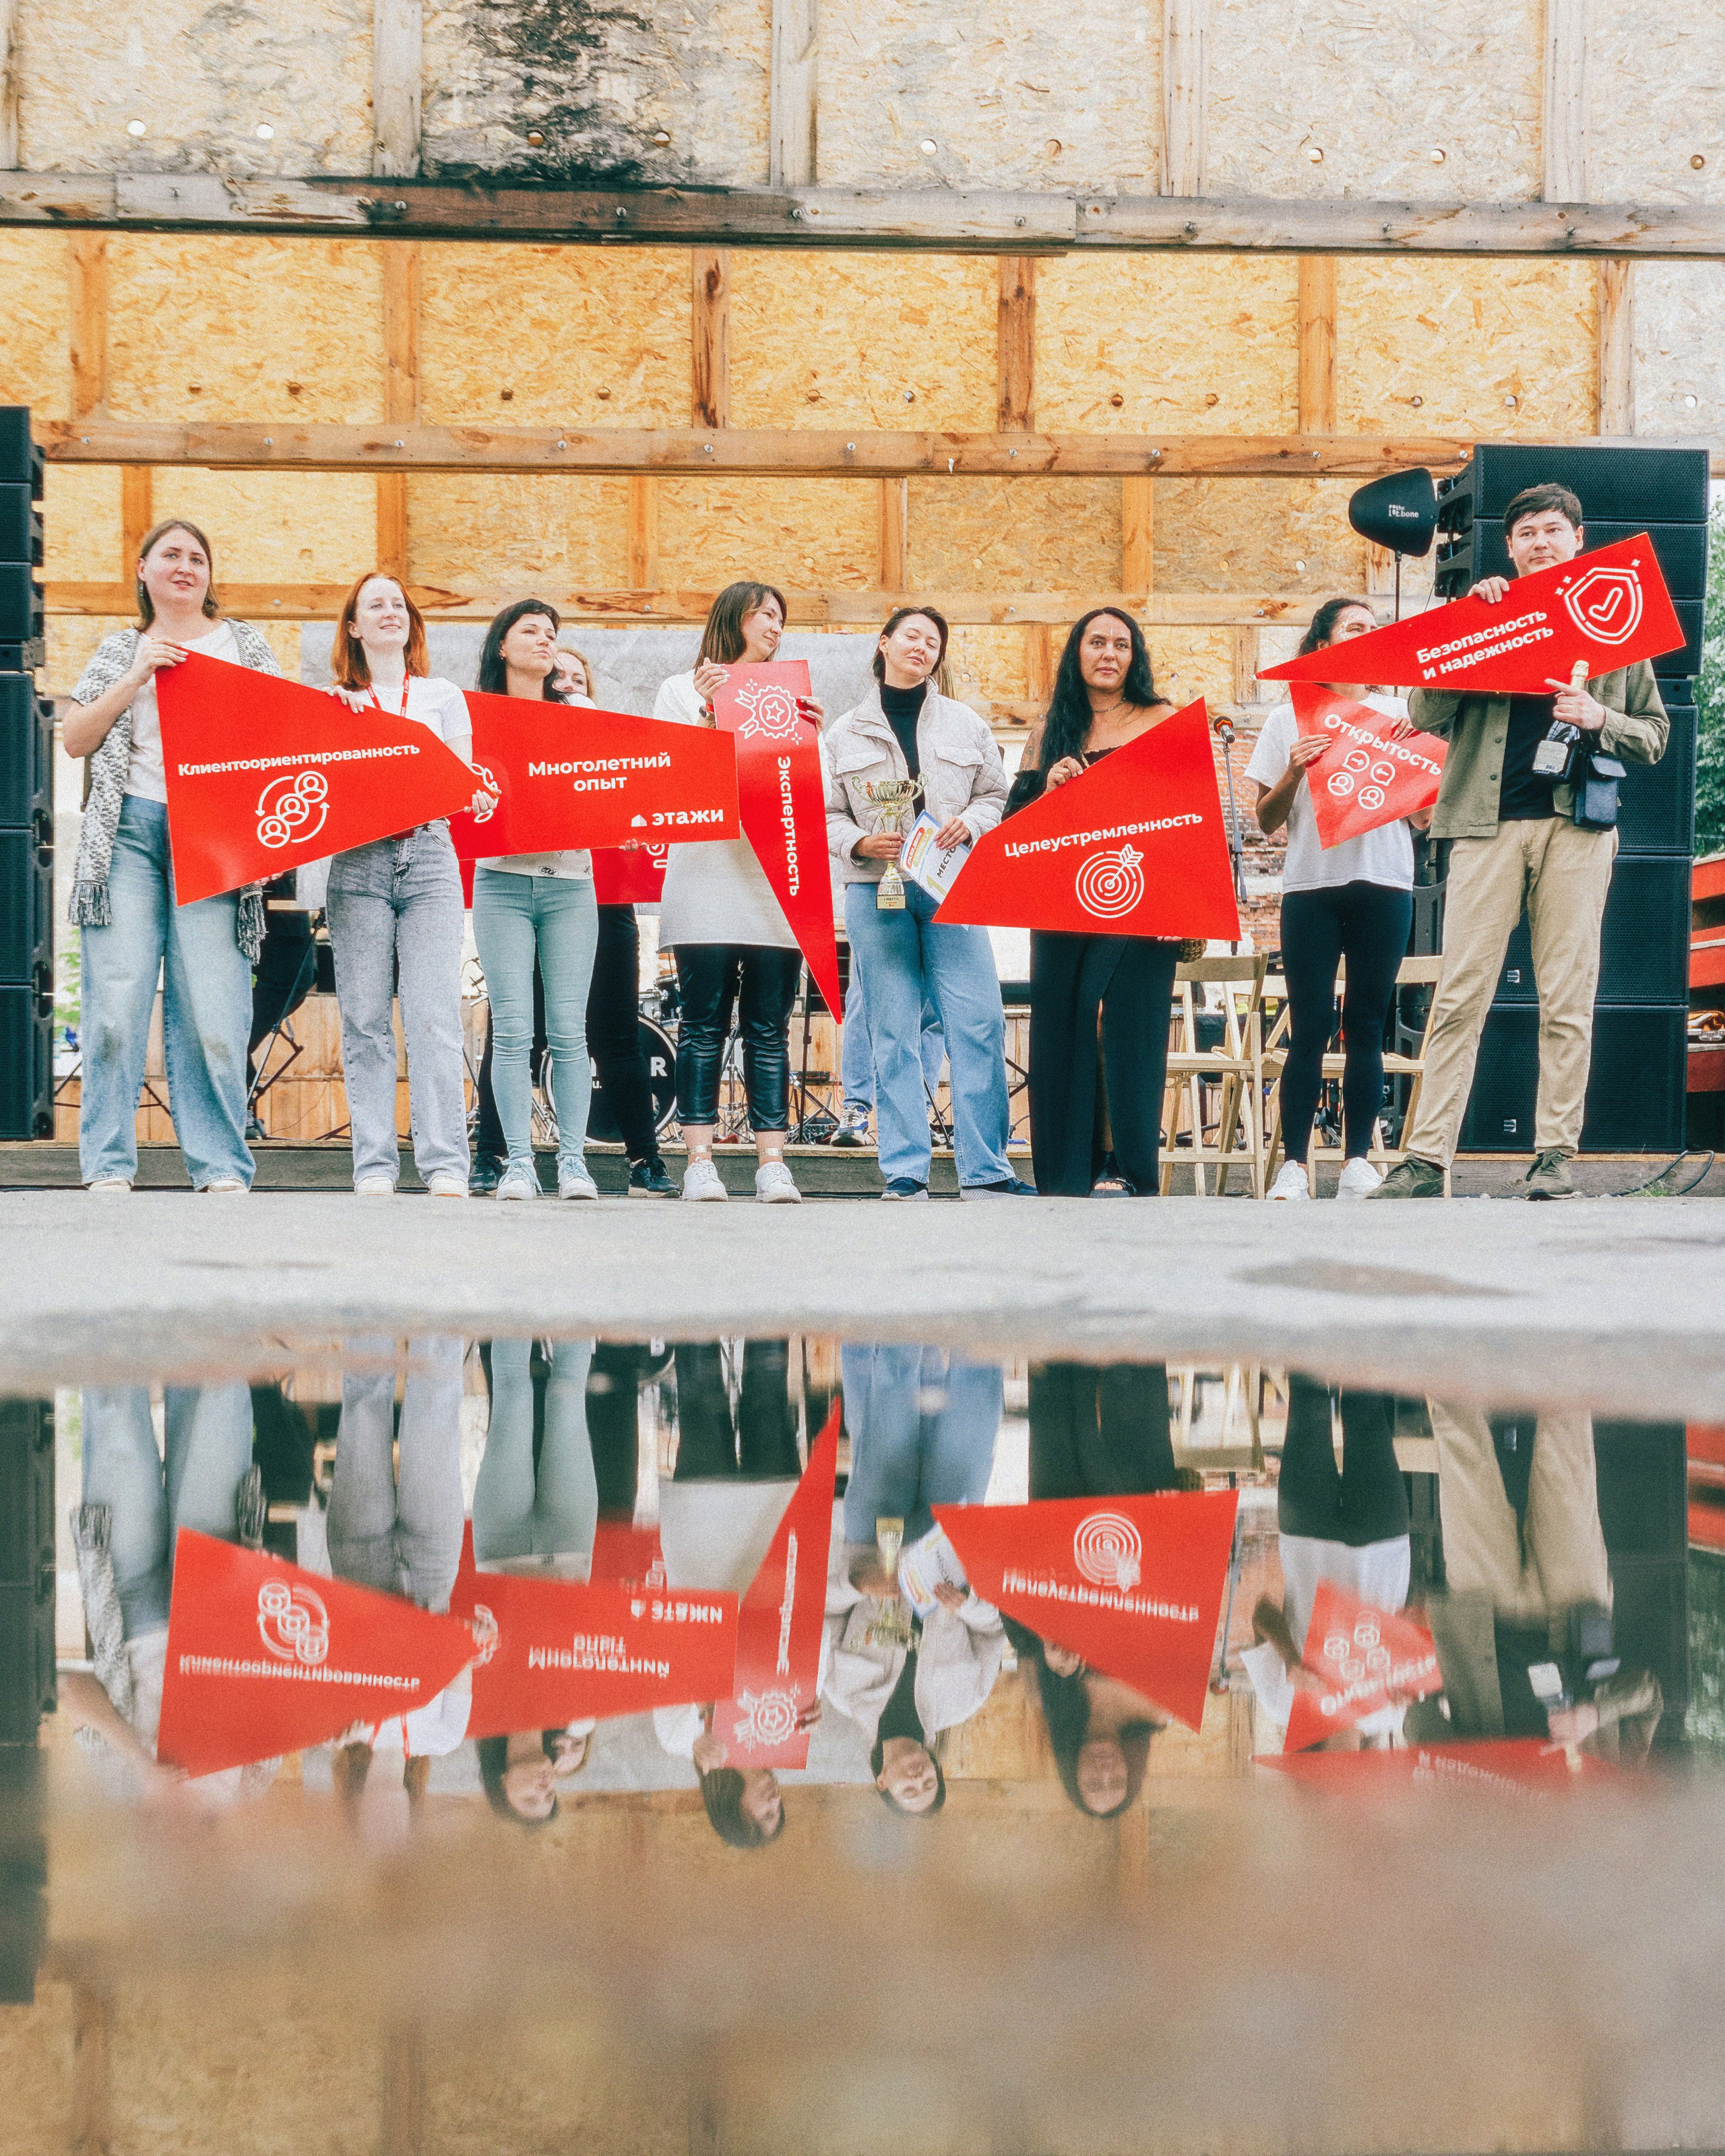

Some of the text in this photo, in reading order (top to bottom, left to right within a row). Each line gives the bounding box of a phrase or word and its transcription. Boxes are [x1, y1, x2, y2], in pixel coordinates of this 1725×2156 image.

[1416, 611, 1546, 664] Безопасность
[1422, 627, 1553, 680] и надежность
[178, 744, 420, 776] Клиентоориентированность
[1324, 714, 1442, 775] Открытость
[528, 752, 670, 777] Многолетний
[573, 776, 627, 792] опыт
[652, 809, 724, 826] этажи
[777, 756, 800, 897] Экспертность
[1004, 813, 1203, 858] Целеустремленность
[937, 847, 956, 879] МЕСТО
